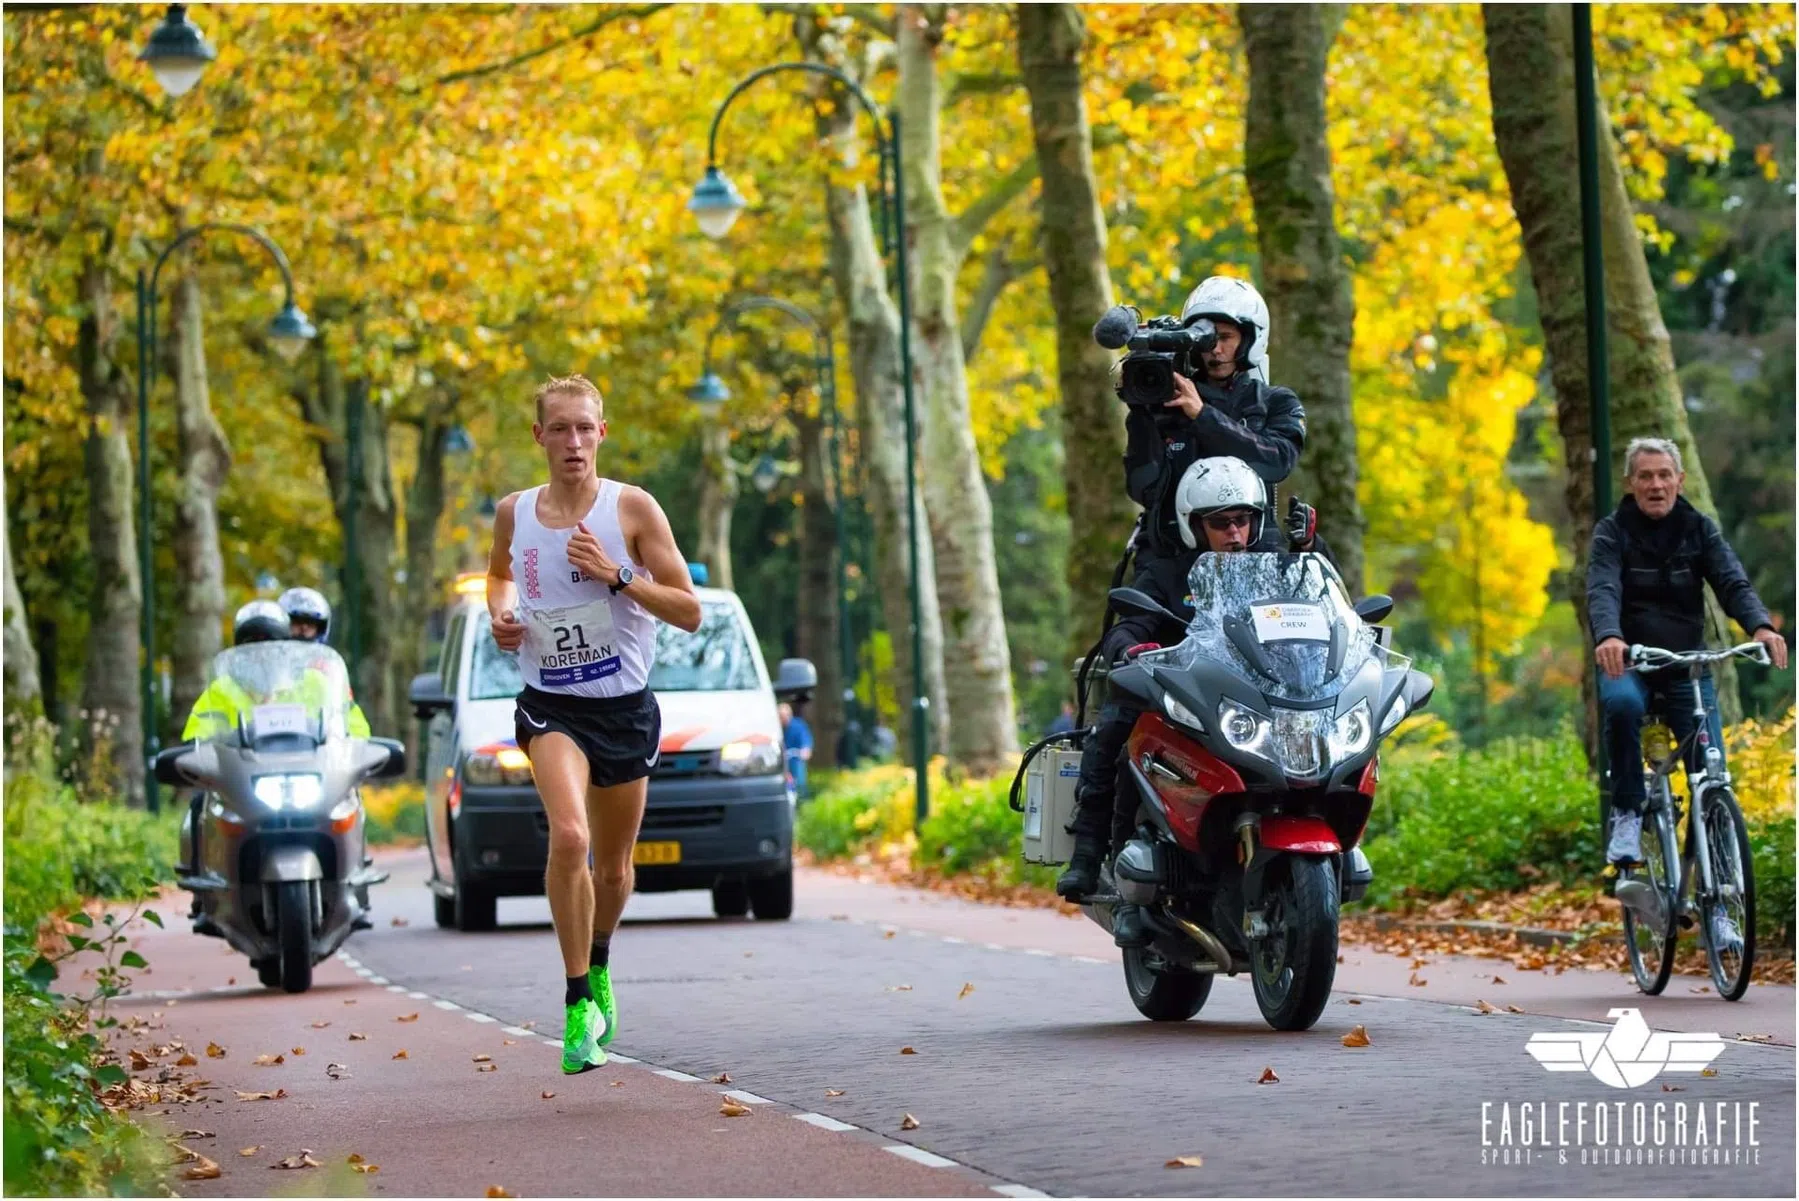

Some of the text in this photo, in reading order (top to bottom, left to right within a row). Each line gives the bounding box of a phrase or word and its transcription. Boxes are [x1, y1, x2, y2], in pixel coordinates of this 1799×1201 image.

[1280, 621, 1307, 629] CREW
[553, 624, 590, 652] 21
[541, 645, 612, 669] KOREMAN
